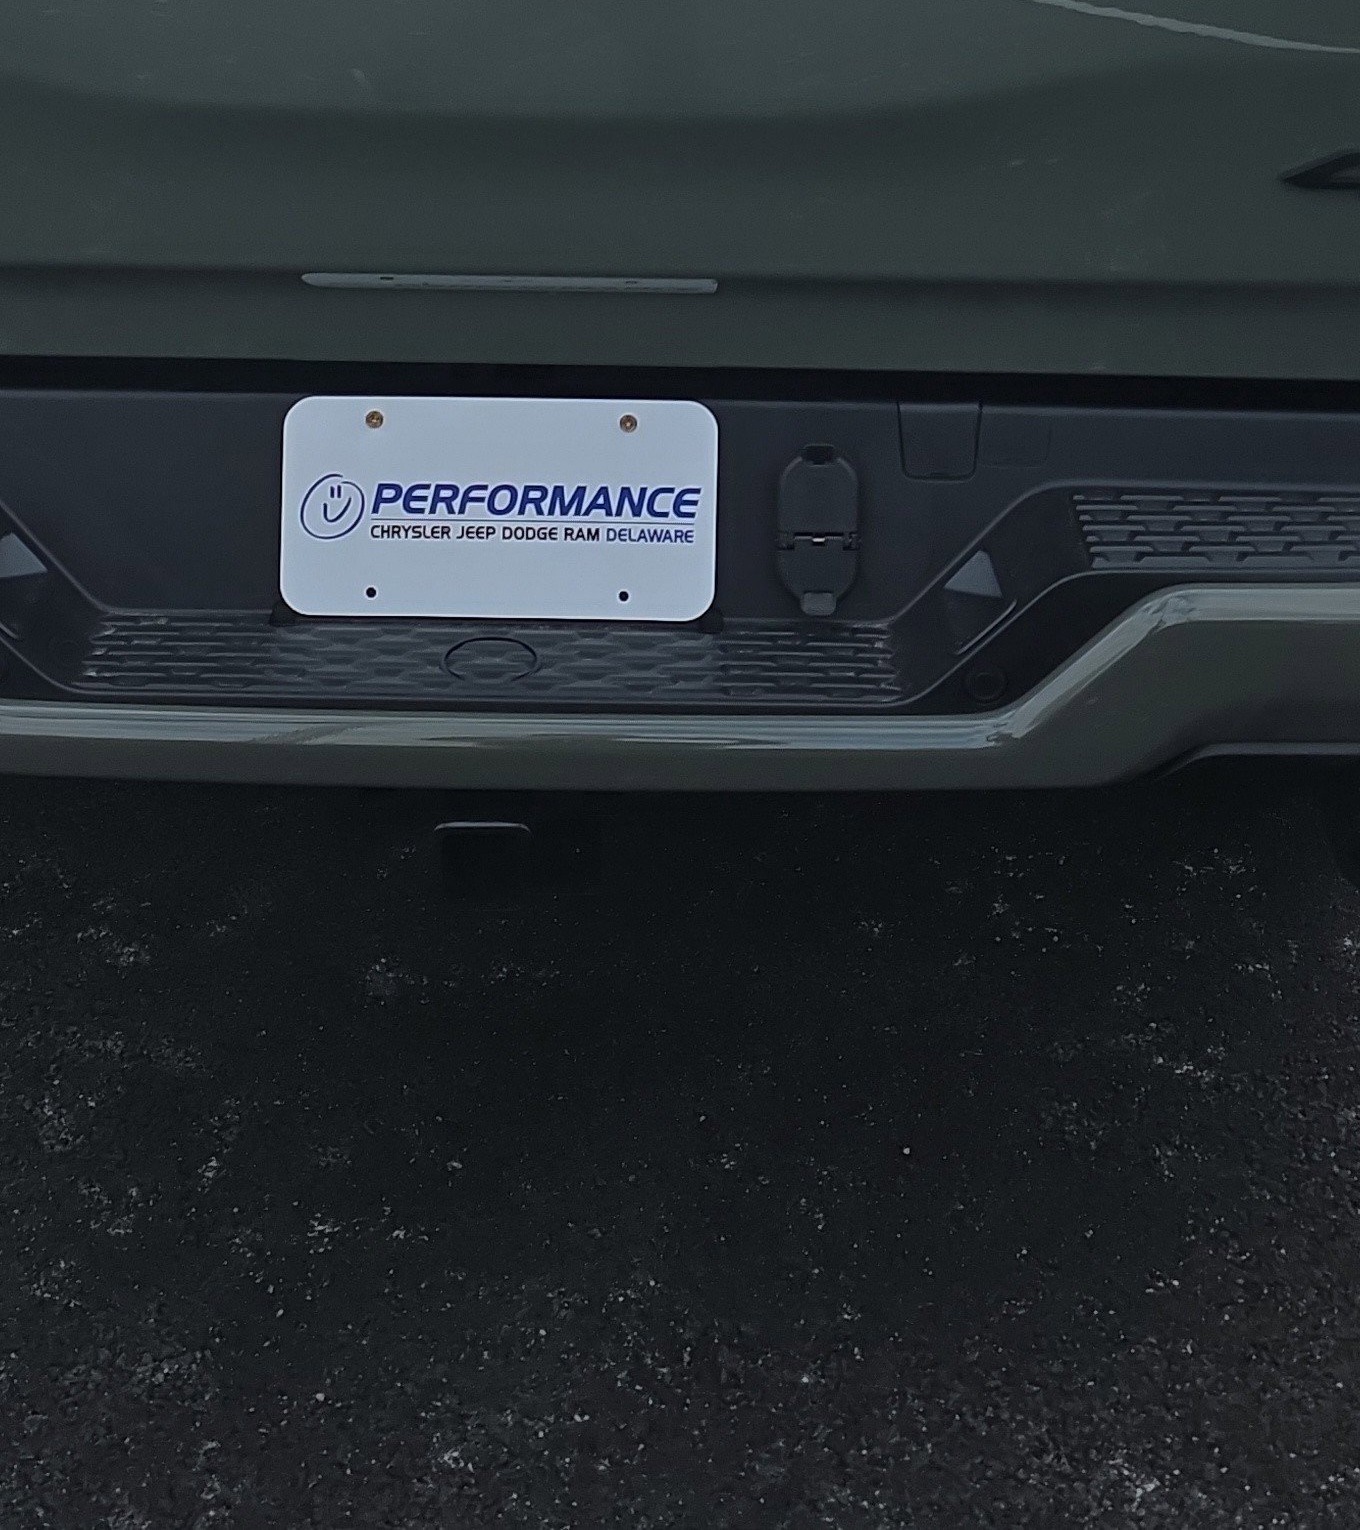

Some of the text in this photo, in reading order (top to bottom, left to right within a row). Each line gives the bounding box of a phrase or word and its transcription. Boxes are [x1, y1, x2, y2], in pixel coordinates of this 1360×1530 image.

[371, 482, 702, 519] PERFORMANCE
[370, 524, 695, 544] CHRYSLER JEEP DODGE RAM DELAWARE
